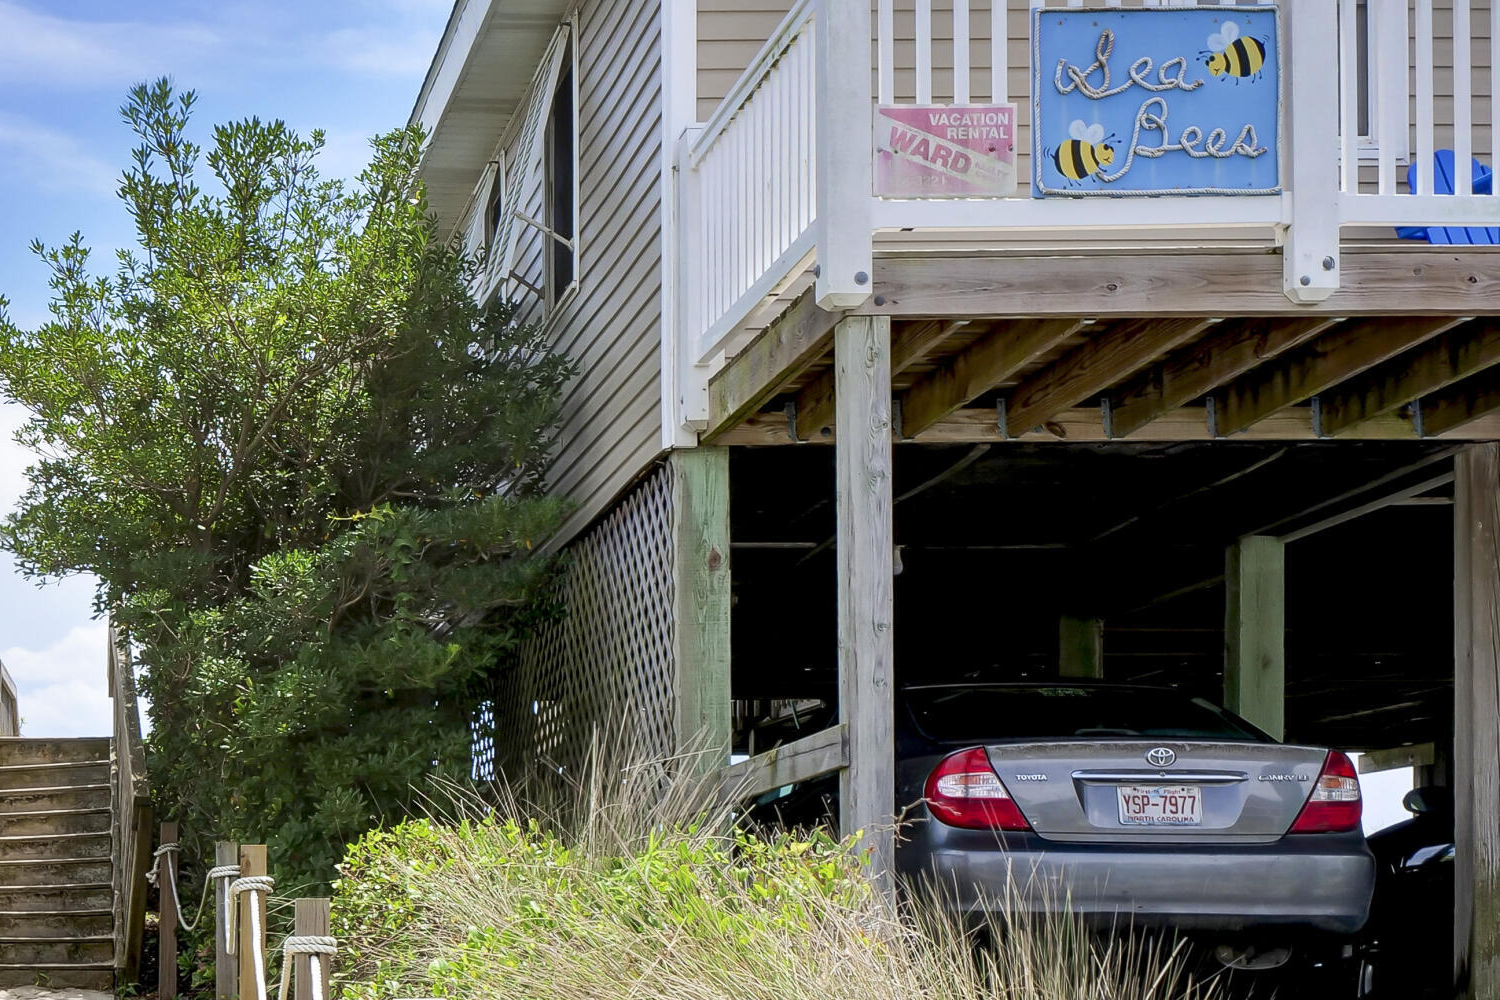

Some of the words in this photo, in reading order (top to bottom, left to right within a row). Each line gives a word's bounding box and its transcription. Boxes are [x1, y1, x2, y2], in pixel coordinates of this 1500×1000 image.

[1055, 29, 1204, 100] Sea
[929, 112, 1009, 126] VACATION
[947, 127, 1009, 140] RENTAL
[889, 125, 972, 174] WARD
[1097, 97, 1268, 183] Bees
[1122, 795, 1197, 815] YSP-7977
